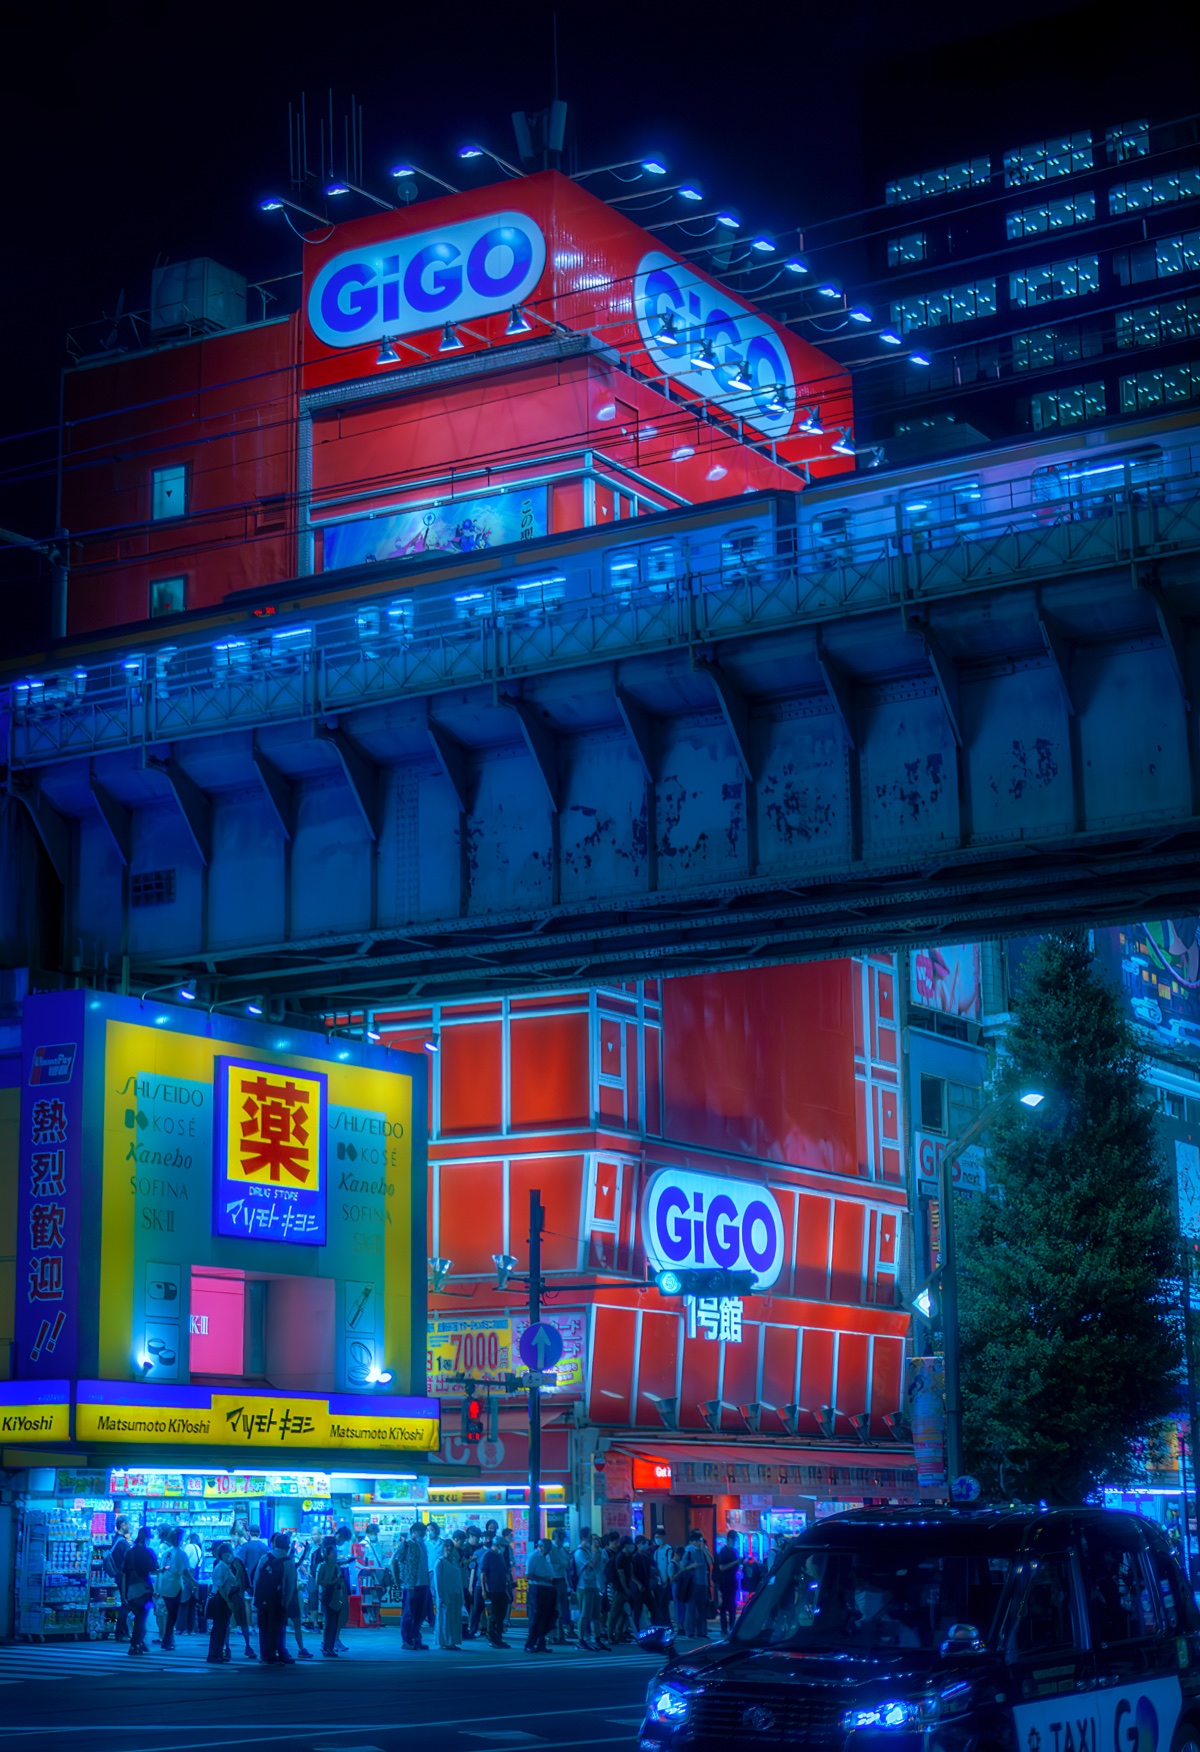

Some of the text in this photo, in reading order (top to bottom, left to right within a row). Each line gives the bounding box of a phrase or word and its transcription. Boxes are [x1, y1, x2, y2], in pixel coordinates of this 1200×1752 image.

[321, 226, 533, 333] GiGO
[644, 270, 787, 421] GiGO
[116, 1076, 204, 1108] SHISEIDO
[240, 1076, 310, 1183] 薬
[329, 1111, 404, 1139] SHISEIDO
[126, 1141, 193, 1170] Kanebo
[130, 1176, 189, 1201] SOFINA
[249, 1186, 299, 1201] DRUG STORE
[338, 1172, 395, 1197] Kanebo
[342, 1204, 392, 1226] SOFINA
[656, 1185, 777, 1273] GiGO
[450, 1332, 499, 1371] 7000
[2, 1416, 53, 1431] KiYoshi
[97, 1416, 211, 1434] Matsumoto KiYoshi
[330, 1424, 424, 1441] Matsumoto KiYoshi
[1049, 1695, 1159, 1752] TAXI GO
